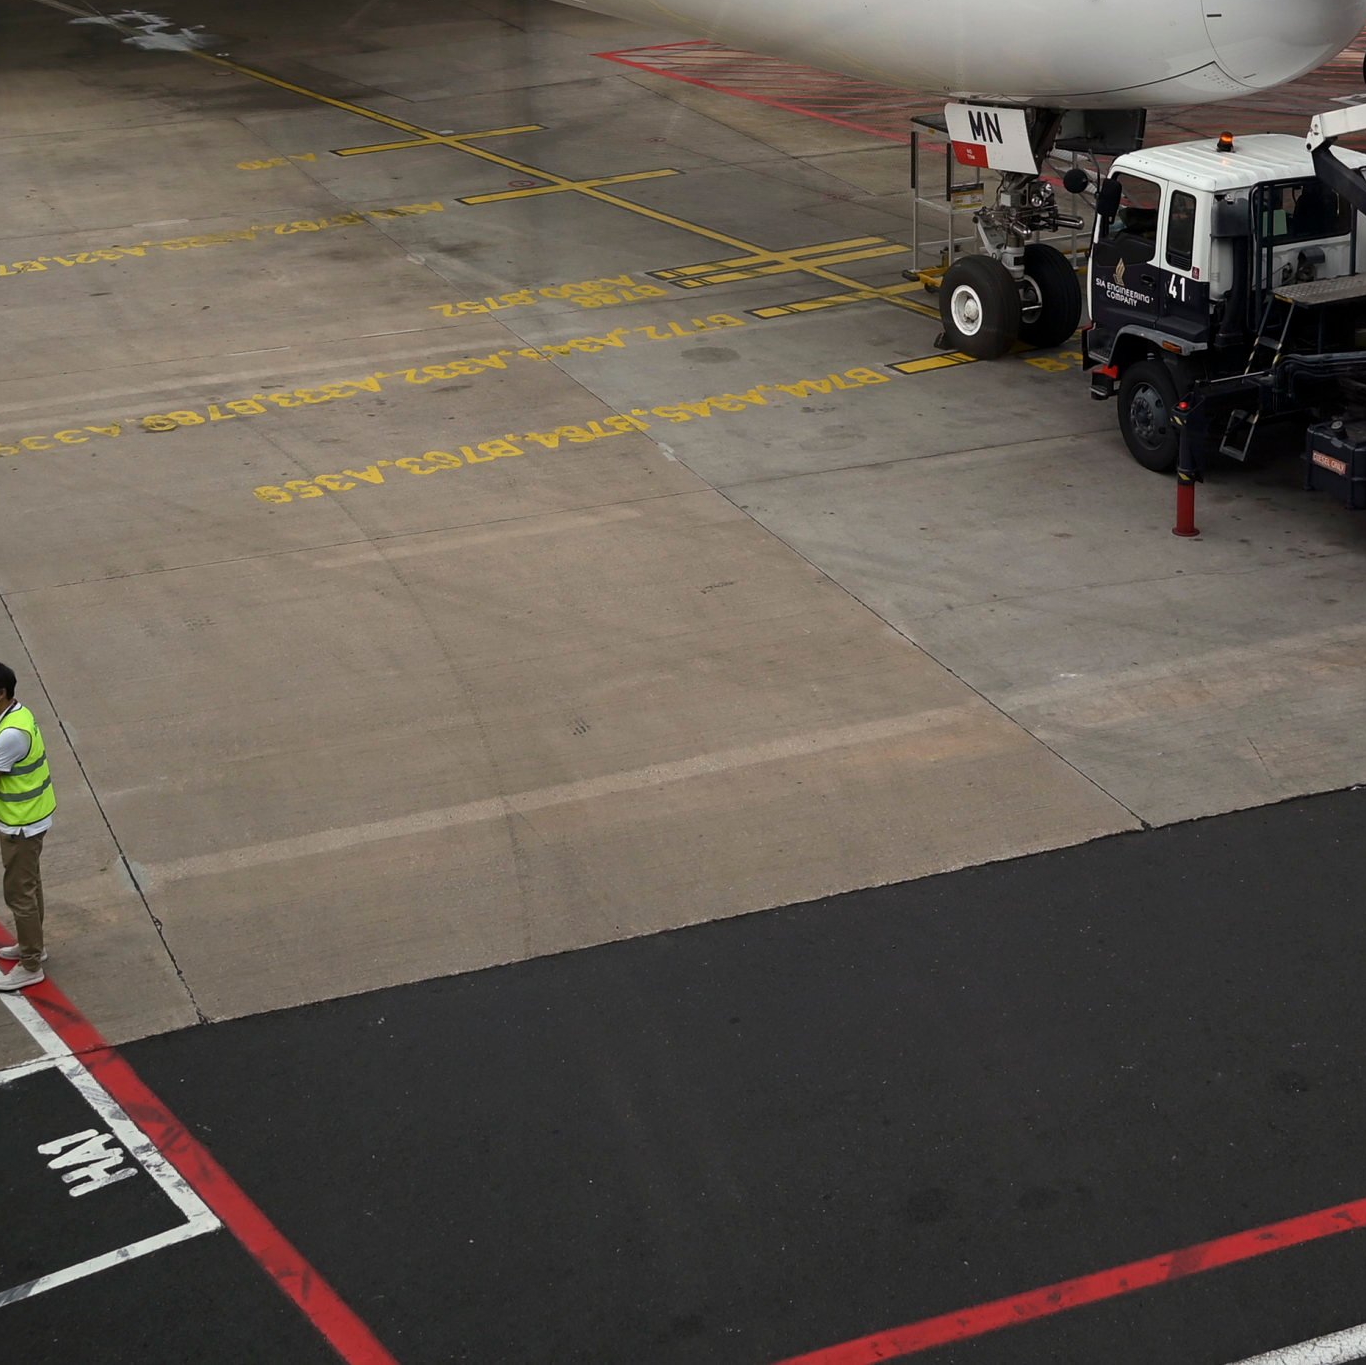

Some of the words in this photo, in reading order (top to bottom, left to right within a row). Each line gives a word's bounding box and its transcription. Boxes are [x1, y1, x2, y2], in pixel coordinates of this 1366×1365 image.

[968, 110, 1003, 144] MN
[1095, 277, 1106, 288] SIA
[1107, 282, 1150, 304] ENGINEERING
[1106, 289, 1138, 307] COMPANY
[1168, 274, 1186, 302] 41
